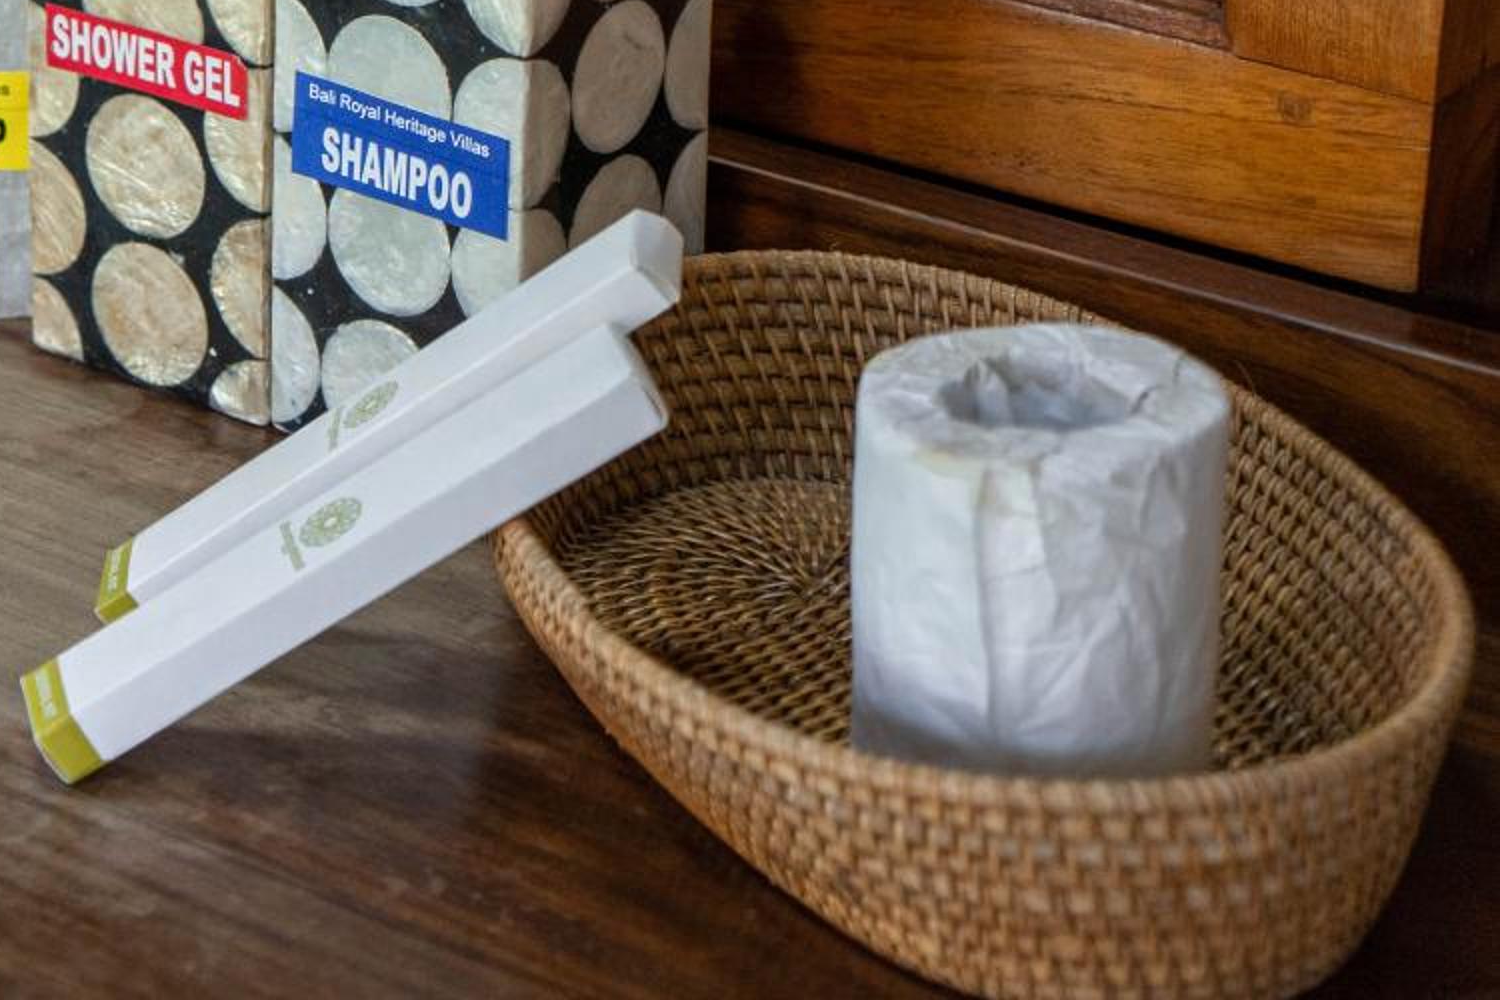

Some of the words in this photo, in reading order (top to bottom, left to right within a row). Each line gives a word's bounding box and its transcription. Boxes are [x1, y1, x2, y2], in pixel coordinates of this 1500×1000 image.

[51, 13, 177, 90] SHOWER
[183, 50, 241, 108] GEL
[308, 83, 336, 101] Bali
[340, 93, 381, 120] Royal
[385, 109, 447, 144] Heritage
[450, 130, 491, 158] Villas
[321, 126, 473, 219] SHAMPOO
